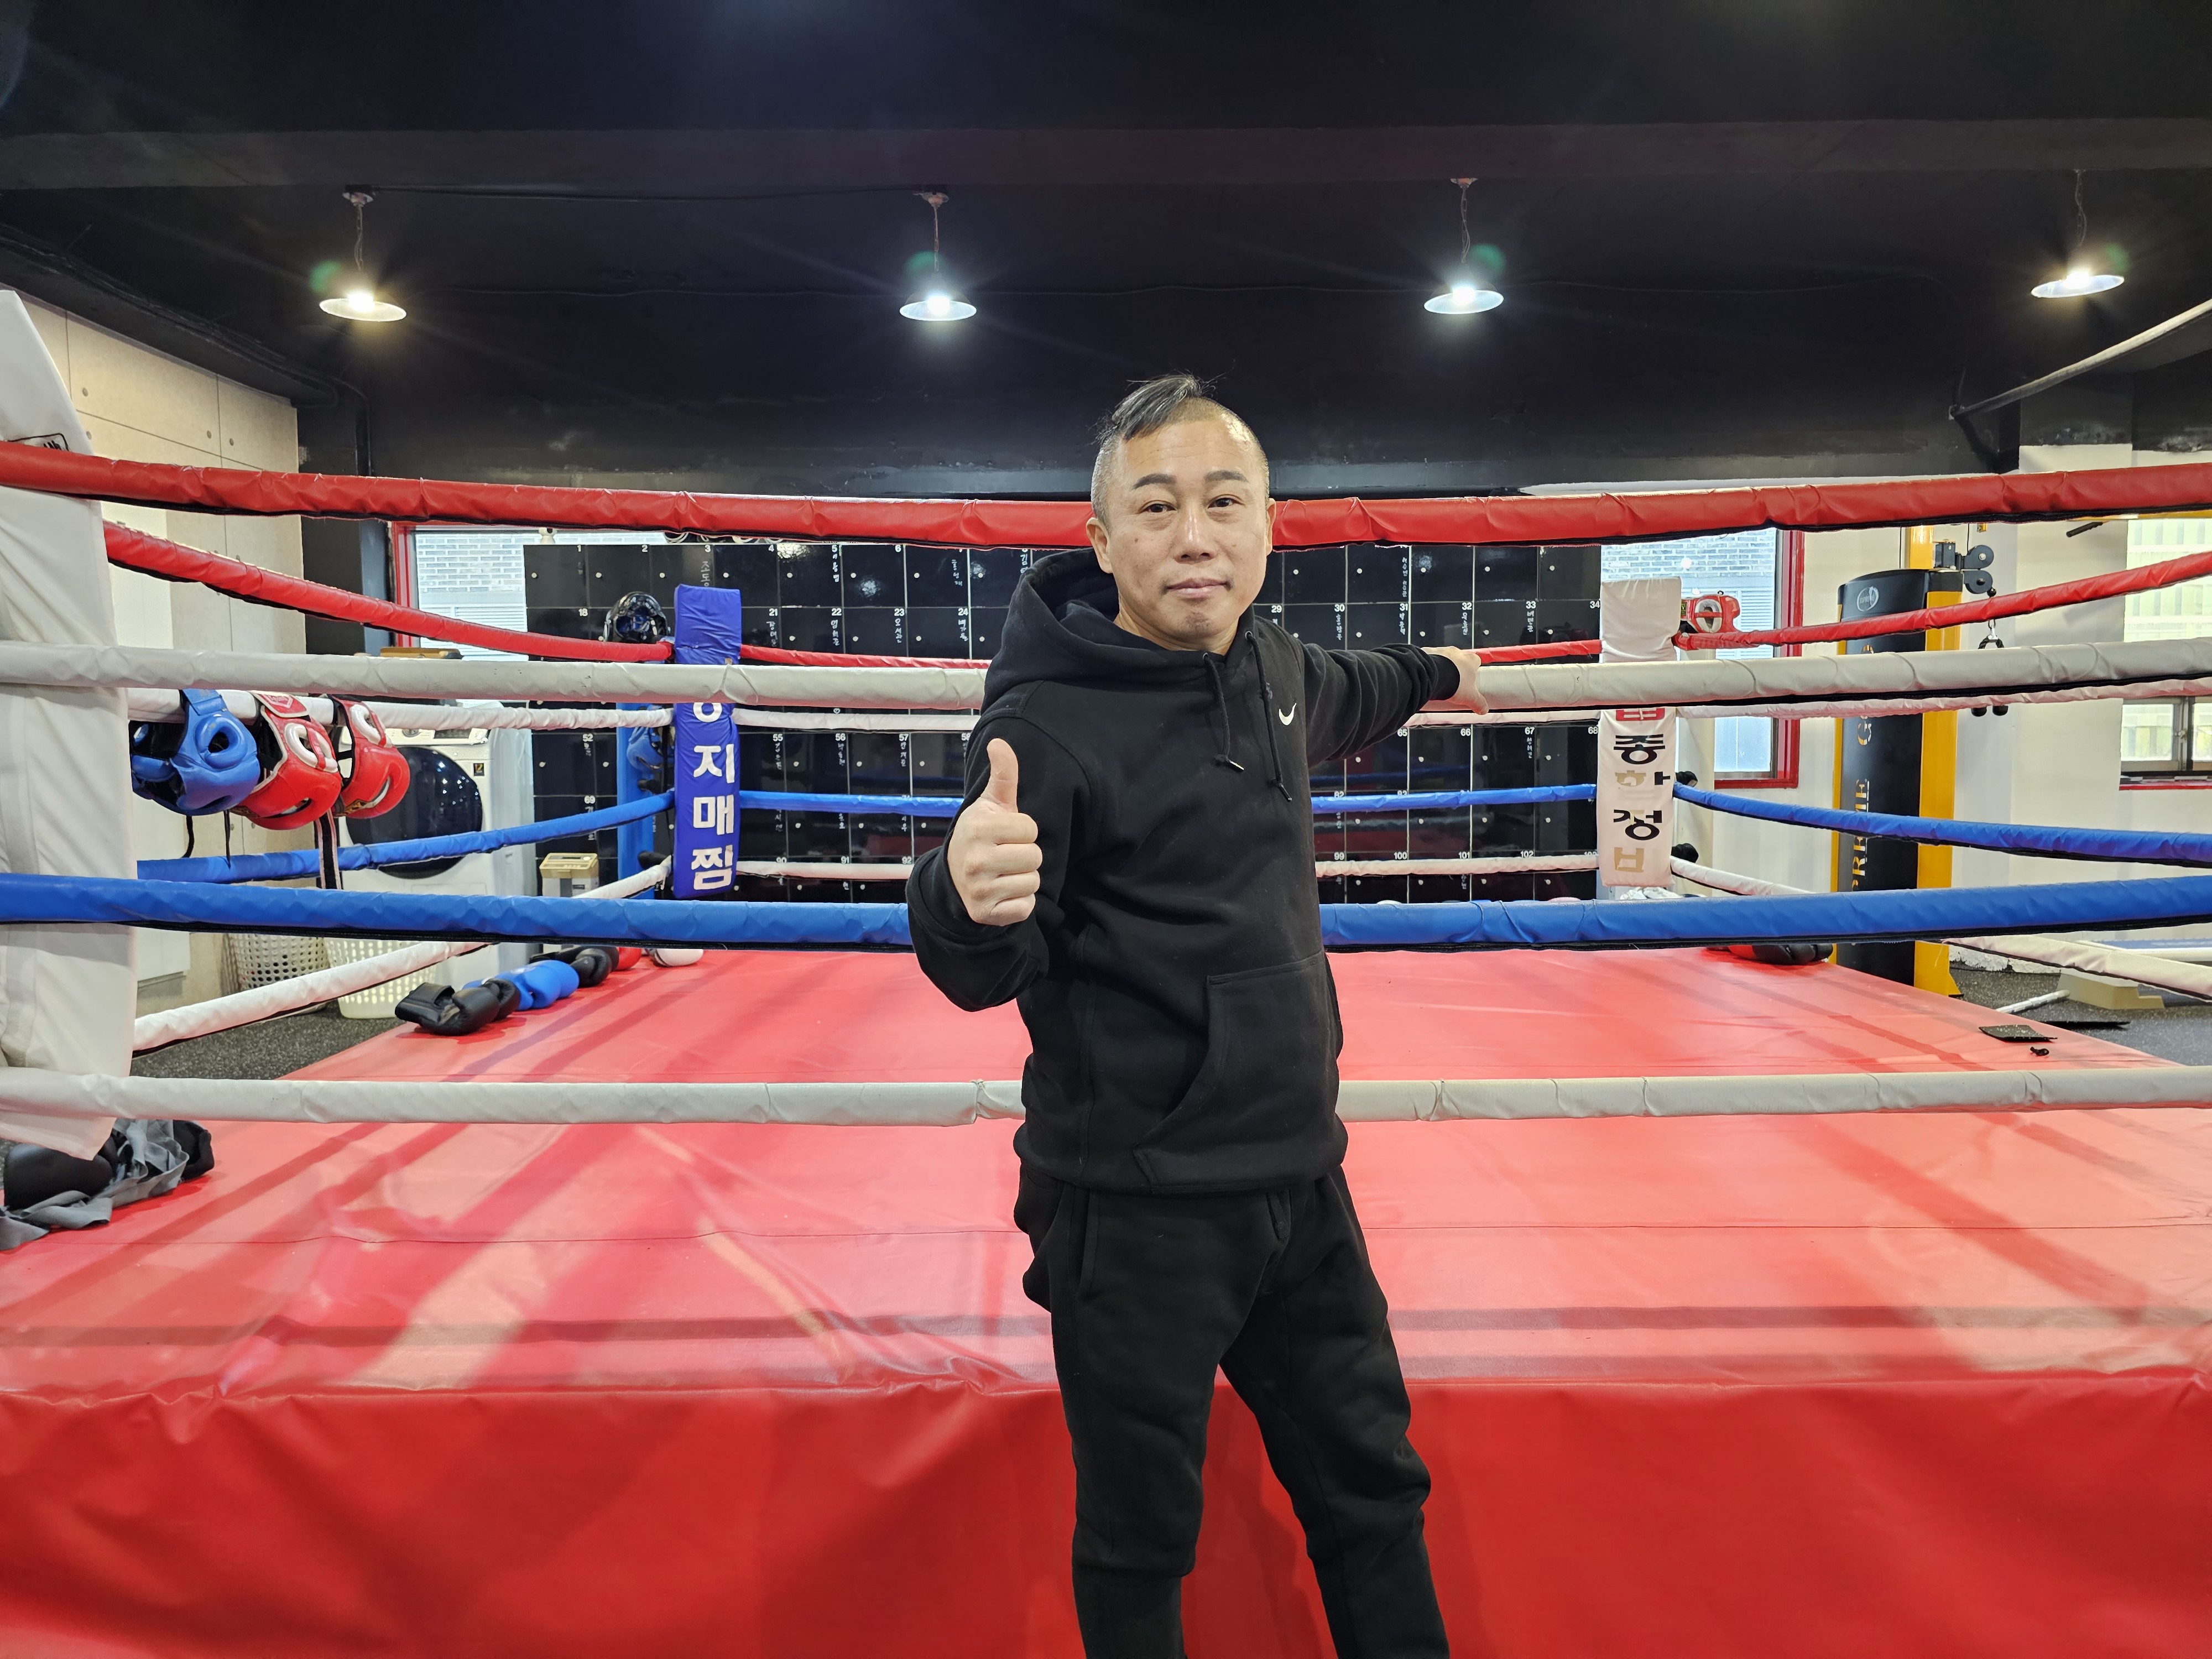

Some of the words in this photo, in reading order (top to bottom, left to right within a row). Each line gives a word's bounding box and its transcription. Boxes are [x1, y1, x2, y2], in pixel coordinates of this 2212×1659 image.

[705, 545, 711, 553] 3
[768, 544, 775, 552] 4
[831, 544, 838, 553] 5
[1271, 604, 1282, 613] 29
[1334, 603, 1345, 612] 30
[1399, 603, 1408, 612] 31
[1462, 602, 1472, 611] 32
[1526, 600, 1536, 609] 33
[1589, 600, 1600, 609] 34
[578, 608, 588, 617] 18
[769, 608, 778, 617] 21
[831, 607, 842, 616] 22
[894, 608, 905, 617] 23
[957, 607, 969, 616] 24
[1397, 728, 1408, 737] 65
[1460, 728, 1471, 737] 66
[1525, 726, 1535, 735] 67
[1588, 726, 1599, 734] 68
[582, 733, 593, 742] 52
[773, 733, 784, 742] 55
[835, 733, 846, 742] 56
[899, 733, 909, 742] 57
[1334, 852, 1345, 860] 99
[1394, 851, 1408, 860] 100
[1459, 851, 1471, 860] 101
[1520, 850, 1535, 859] 102
[841, 855, 849, 864] 91
[901, 856, 912, 864] 92
